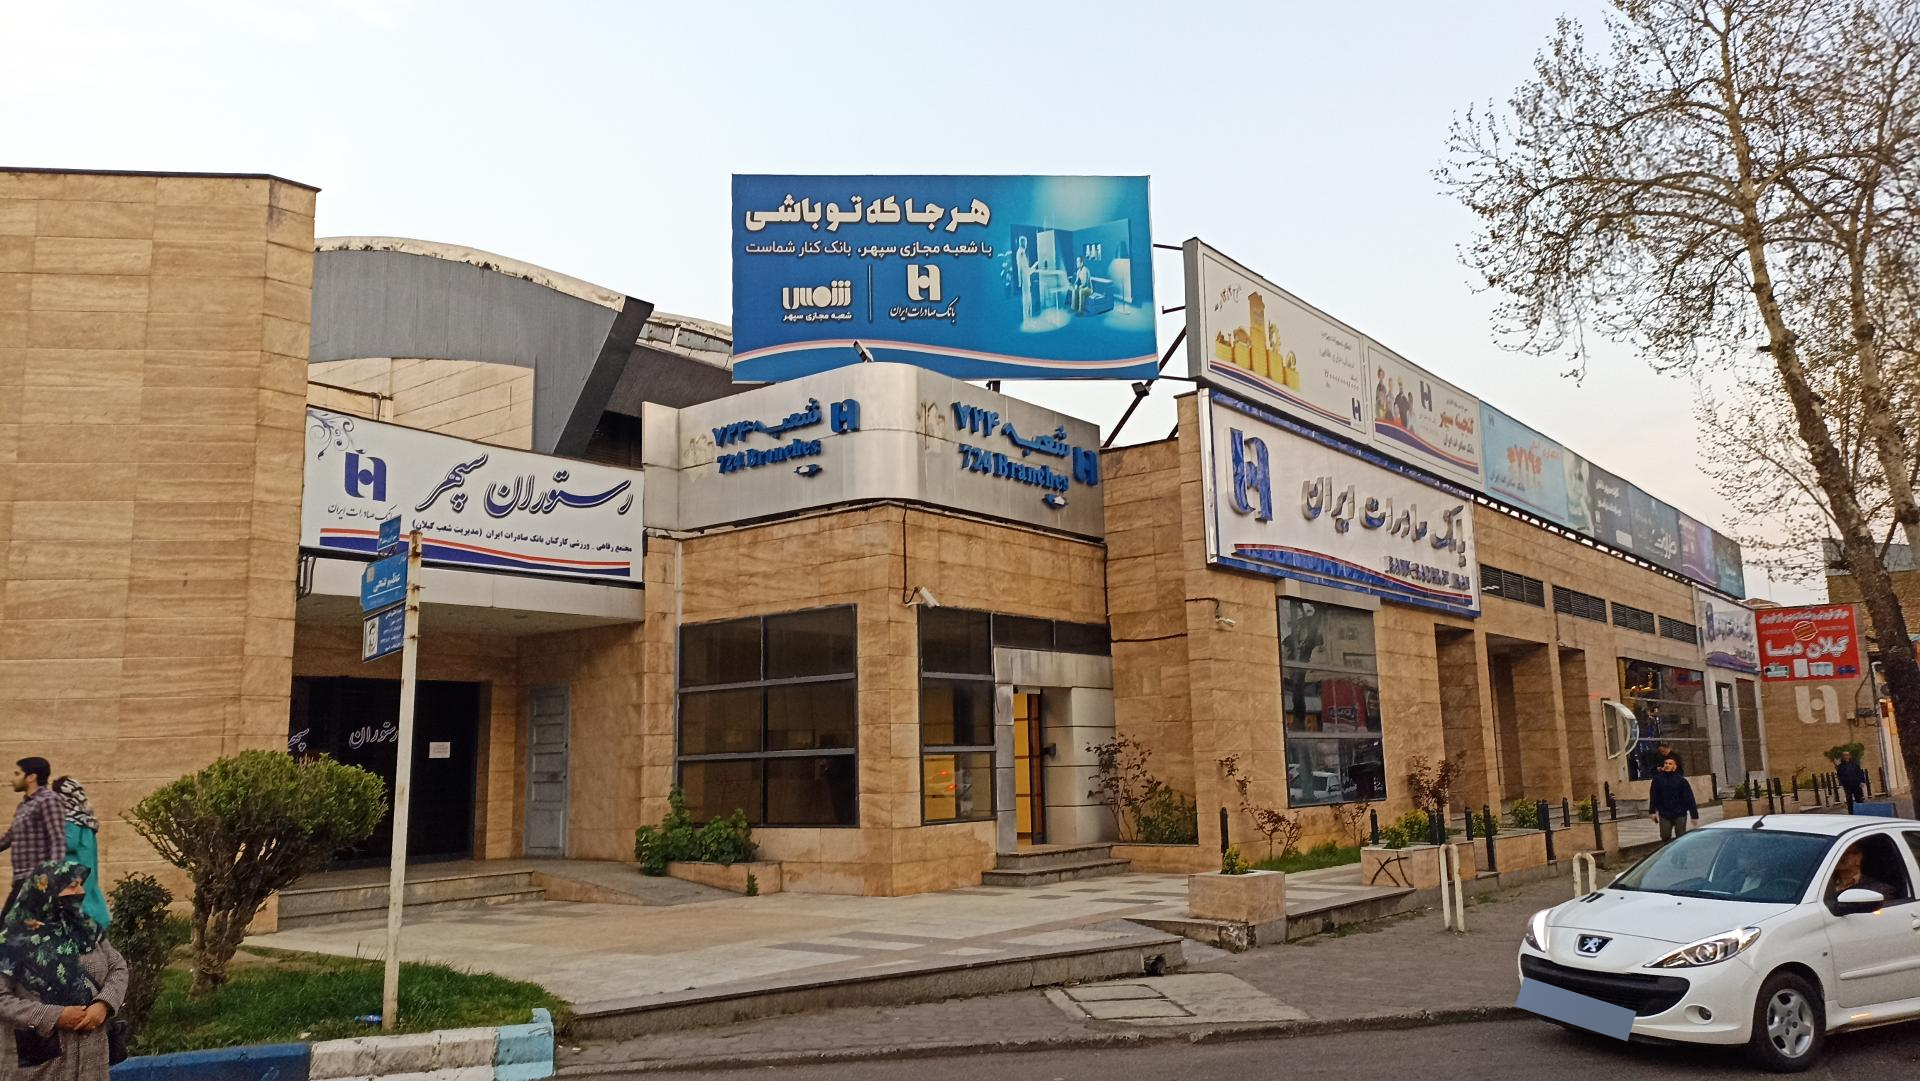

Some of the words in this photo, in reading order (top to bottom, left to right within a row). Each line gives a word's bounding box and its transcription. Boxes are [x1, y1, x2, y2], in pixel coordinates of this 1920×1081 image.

[745, 193, 822, 231] باشی
[826, 195, 863, 232] تو
[866, 195, 901, 224] که
[904, 198, 945, 231] جا
[945, 198, 991, 232] هر
[745, 241, 796, 254] شماست
[798, 241, 821, 257] کنار
[824, 241, 852, 257] بانک
[900, 242, 940, 258] مجازی
[942, 241, 978, 257] شعبه
[980, 241, 992, 257] با
[782, 312, 804, 322] سپهر
[805, 312, 830, 322] مجازی
[830, 311, 853, 321] شعبه
[889, 304, 908, 321] ایران
[907, 304, 937, 318] صادرات
[936, 296, 959, 324] بانک
[752, 397, 823, 440] شعبه
[951, 401, 1001, 438] ۷۲۴
[1000, 423, 1071, 459] شعبه
[716, 451, 746, 475] 724
[745, 438, 823, 469] Branches
[958, 442, 993, 475] 724
[992, 452, 1070, 493] Branches
[414, 450, 489, 513] سپهر
[483, 469, 634, 518] رستوران
[327, 503, 346, 520] ایران
[1301, 476, 1356, 534] ایران
[345, 507, 375, 520] صادرات
[485, 529, 504, 541] ایران
[504, 531, 529, 544] صادرات
[529, 533, 545, 545] بانک
[544, 536, 569, 547] کارکنان
[1430, 504, 1467, 568] بانک
[569, 538, 591, 551] ورزشی
[596, 541, 614, 554] رفاهی
[614, 544, 633, 554] مجتمع
